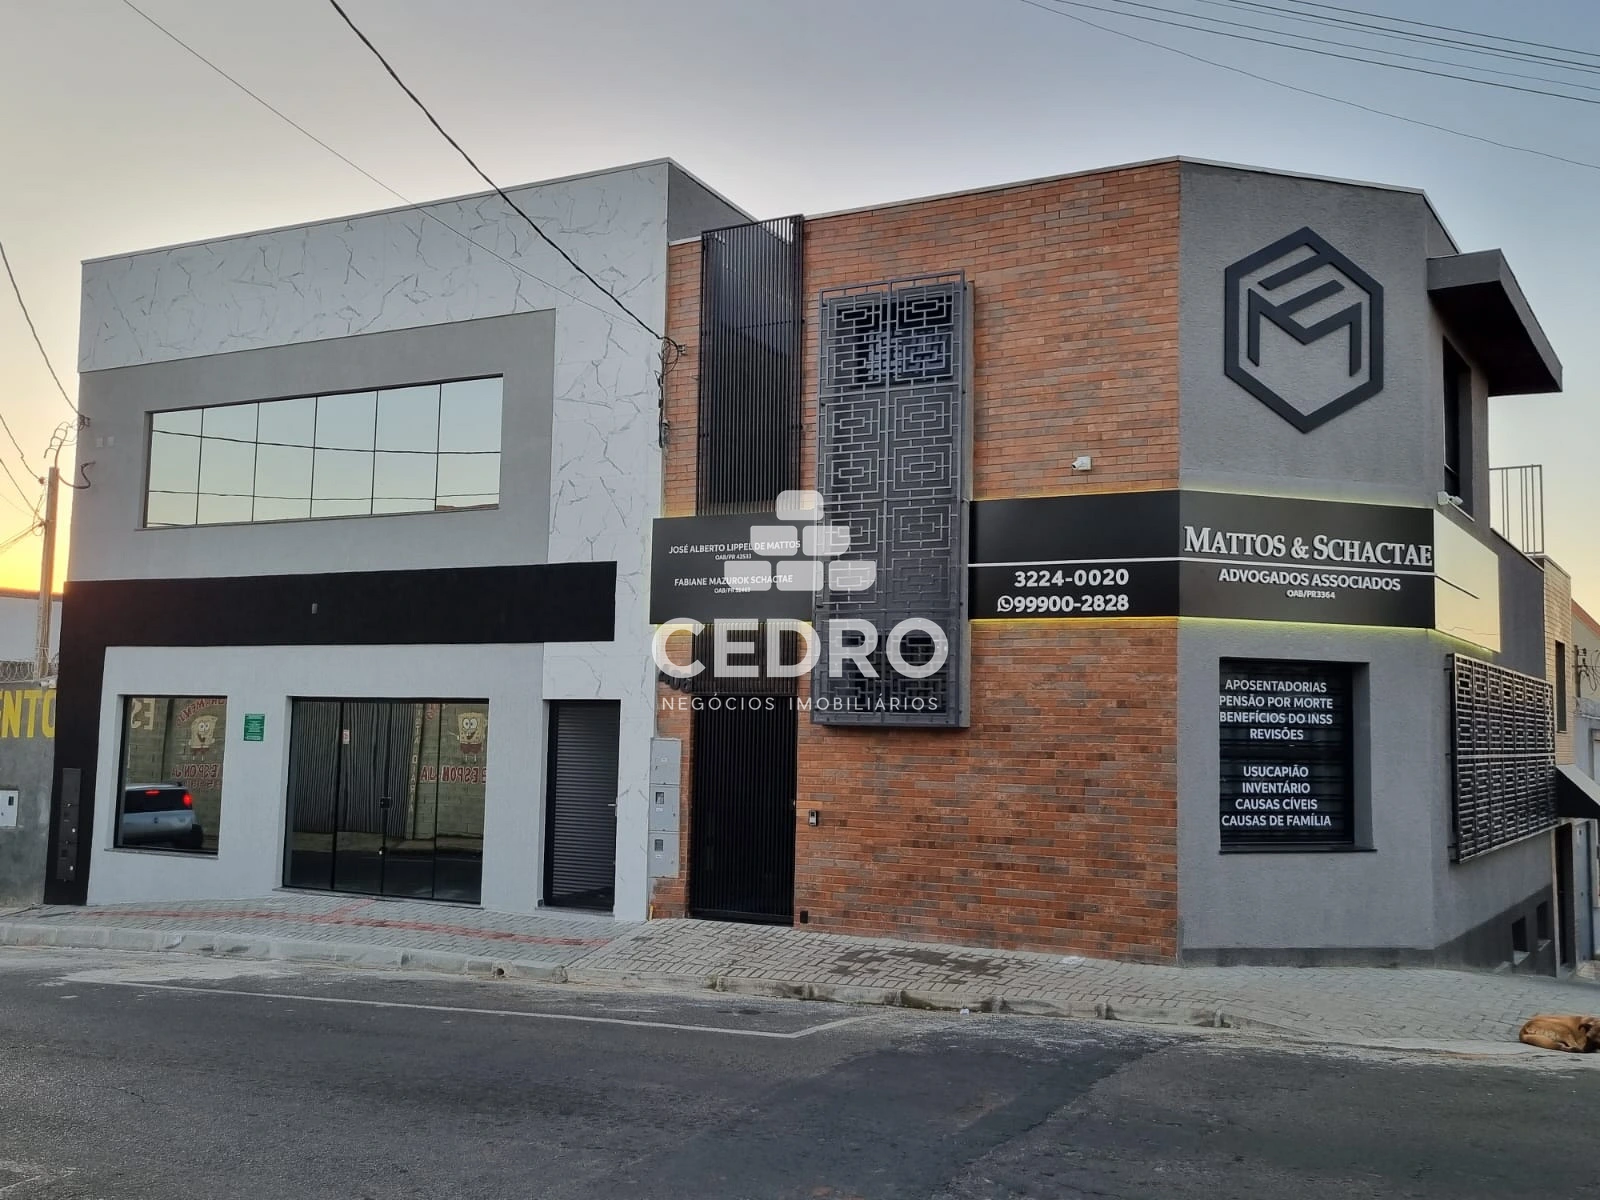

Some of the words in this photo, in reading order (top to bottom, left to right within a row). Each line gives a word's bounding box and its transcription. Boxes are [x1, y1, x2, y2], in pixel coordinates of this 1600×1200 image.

[668, 545, 689, 554] JOSÉ
[689, 544, 725, 553] ALBERTO
[726, 543, 754, 552] LIPPEL
[754, 542, 766, 550] DE
[766, 540, 801, 550] MATTOS
[1184, 525, 1286, 558] MATTOS
[1291, 537, 1310, 559] &
[1312, 535, 1433, 567] SCHACTAE
[674, 578, 708, 587] FABIANE
[708, 576, 750, 585] MAZUROK
[750, 574, 793, 584] SCHACTAE
[1014, 568, 1130, 588] 3224-0020
[1218, 568, 1310, 586] ADVOGADOS
[1311, 574, 1402, 591] ASSOCIADOS
[1013, 594, 1130, 613] 99900-2828
[1225, 679, 1327, 693] APOSENTADORIAS
[1219, 694, 1265, 707] PENSÃO
[1267, 697, 1293, 708] POR
[1293, 697, 1334, 709] MORTE
[0, 689, 57, 738] NTO
[1219, 710, 1286, 724] BENEFÍCIOS
[1288, 713, 1306, 724] DO
[1307, 714, 1333, 725] INSS
[1250, 726, 1304, 740] REVISÕES
[1243, 764, 1309, 777] USUCAPIÃO
[1242, 780, 1311, 794] INVENTÁRIO
[1235, 799, 1280, 810] CAUSAS
[1283, 797, 1318, 810] CÍVEIS
[1221, 815, 1267, 827] CAUSAS
[1269, 816, 1284, 826] DE
[1286, 813, 1332, 827] FAMÍLIA
